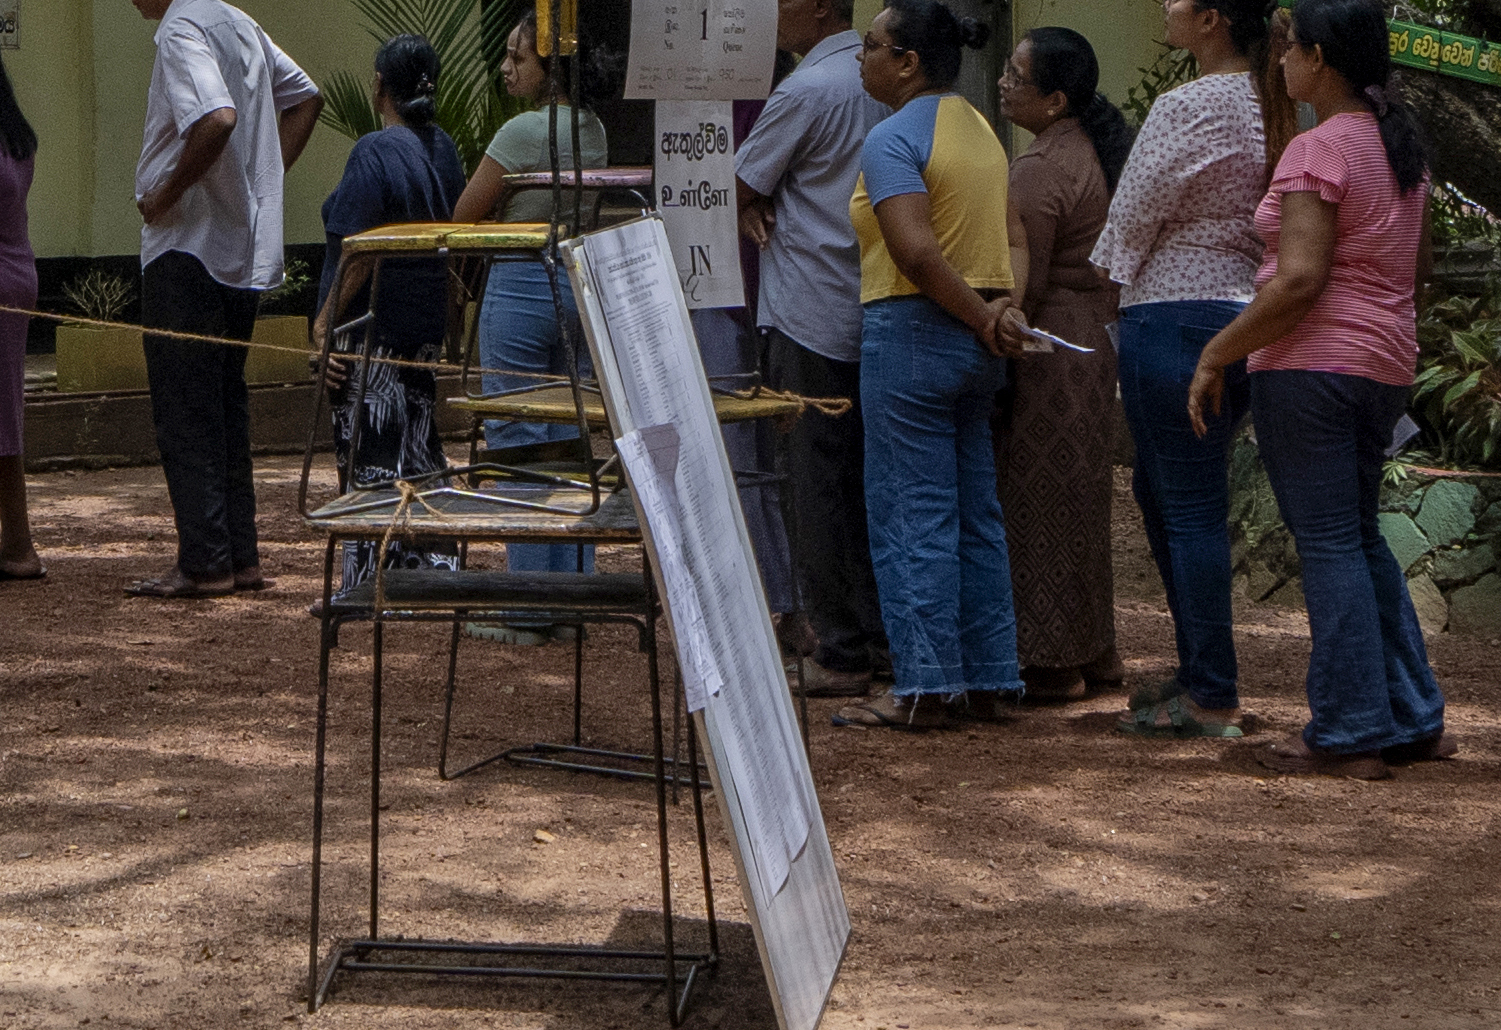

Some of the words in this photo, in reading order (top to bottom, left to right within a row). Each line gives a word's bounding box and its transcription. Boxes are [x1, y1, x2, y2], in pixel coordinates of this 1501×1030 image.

[700, 8, 709, 41] 1
[661, 180, 729, 211] உள்ளே
[689, 245, 713, 276] IN
